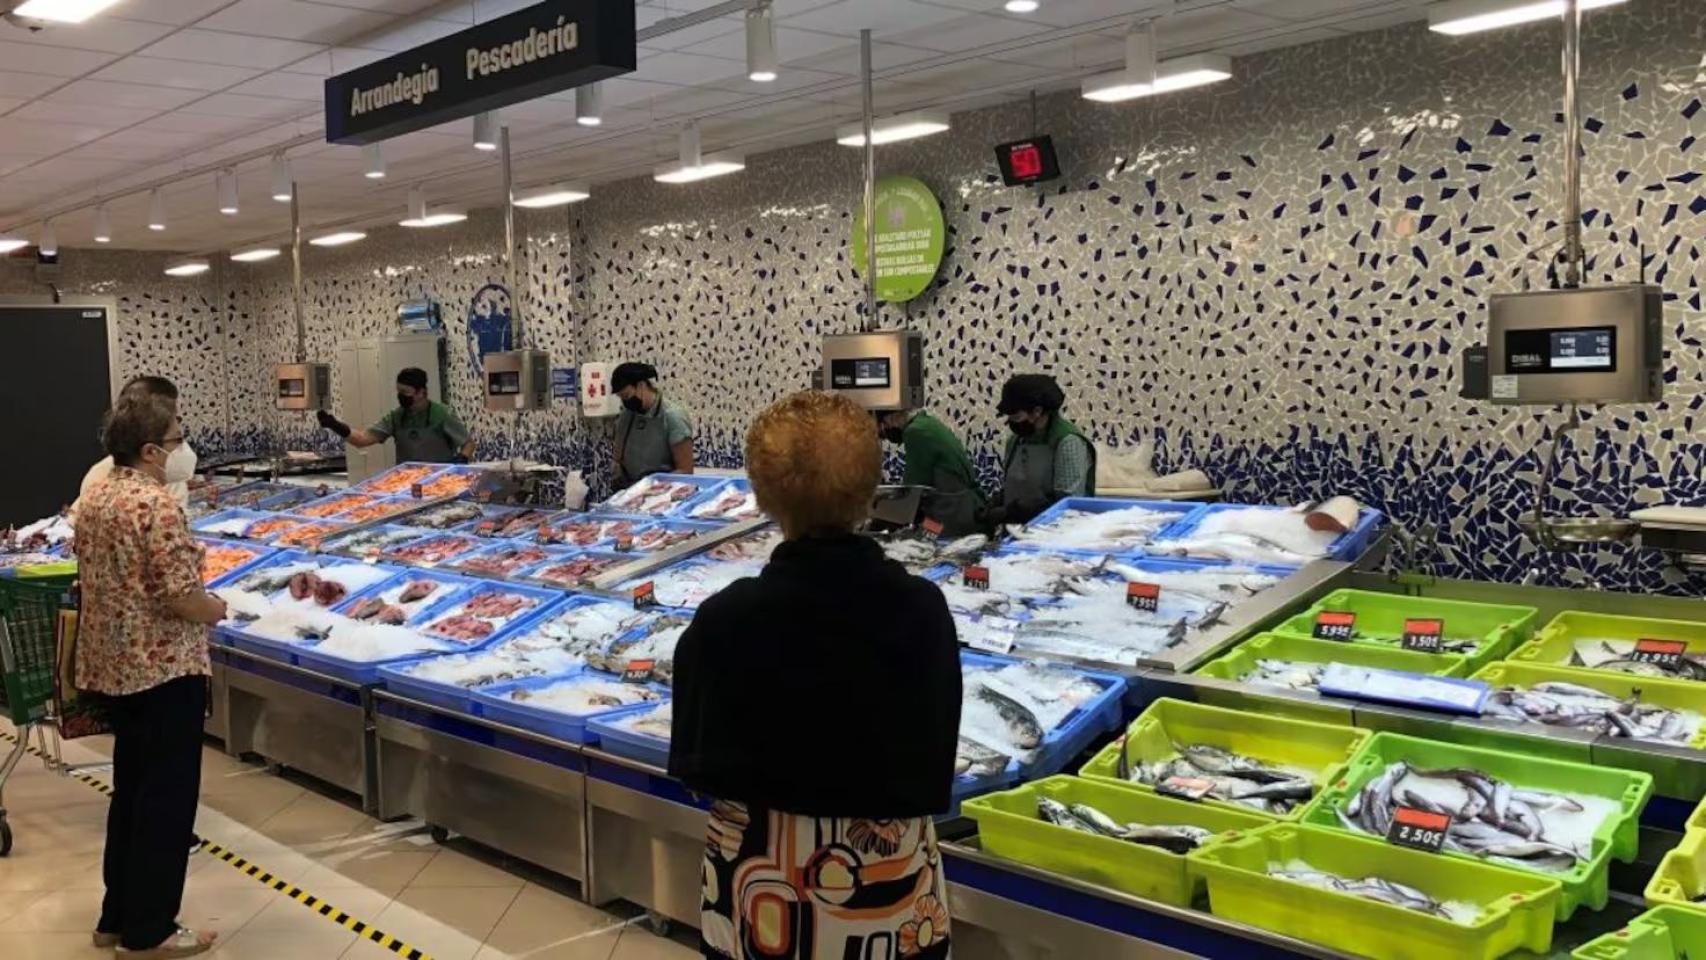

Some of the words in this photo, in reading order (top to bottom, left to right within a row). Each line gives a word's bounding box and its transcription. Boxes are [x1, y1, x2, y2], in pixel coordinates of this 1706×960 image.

[351, 63, 439, 117] Arrandegia
[466, 15, 578, 80] Pescadería
[1399, 825, 1443, 847] 2,50€
